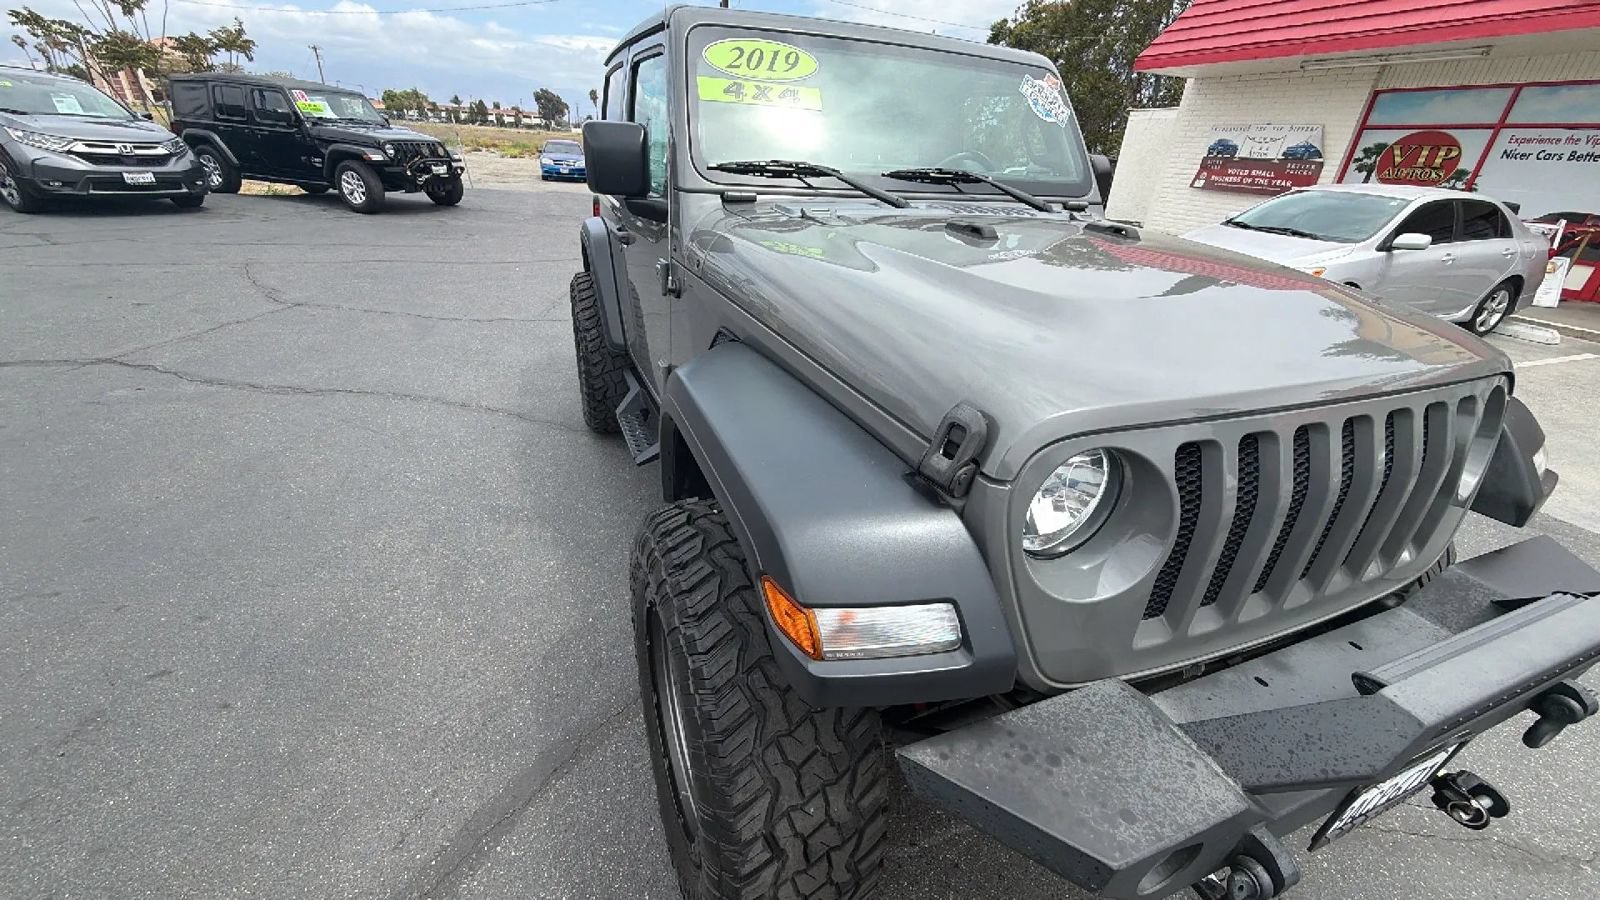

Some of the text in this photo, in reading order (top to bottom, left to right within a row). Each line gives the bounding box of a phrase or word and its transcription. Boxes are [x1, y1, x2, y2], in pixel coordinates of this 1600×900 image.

[725, 46, 800, 72] 2019
[1507, 134, 1562, 147] Experience
[1563, 134, 1581, 145] the
[1391, 144, 1461, 168] VIP
[1500, 148, 1533, 161] Nicer
[1536, 149, 1564, 161] Cars
[1227, 168, 1275, 178] VOTED SMALL
[1380, 166, 1445, 181] AUTOS
[1210, 174, 1241, 183] BUSINESS
[1254, 177, 1270, 186] THE
[1271, 179, 1293, 187] YEAR
